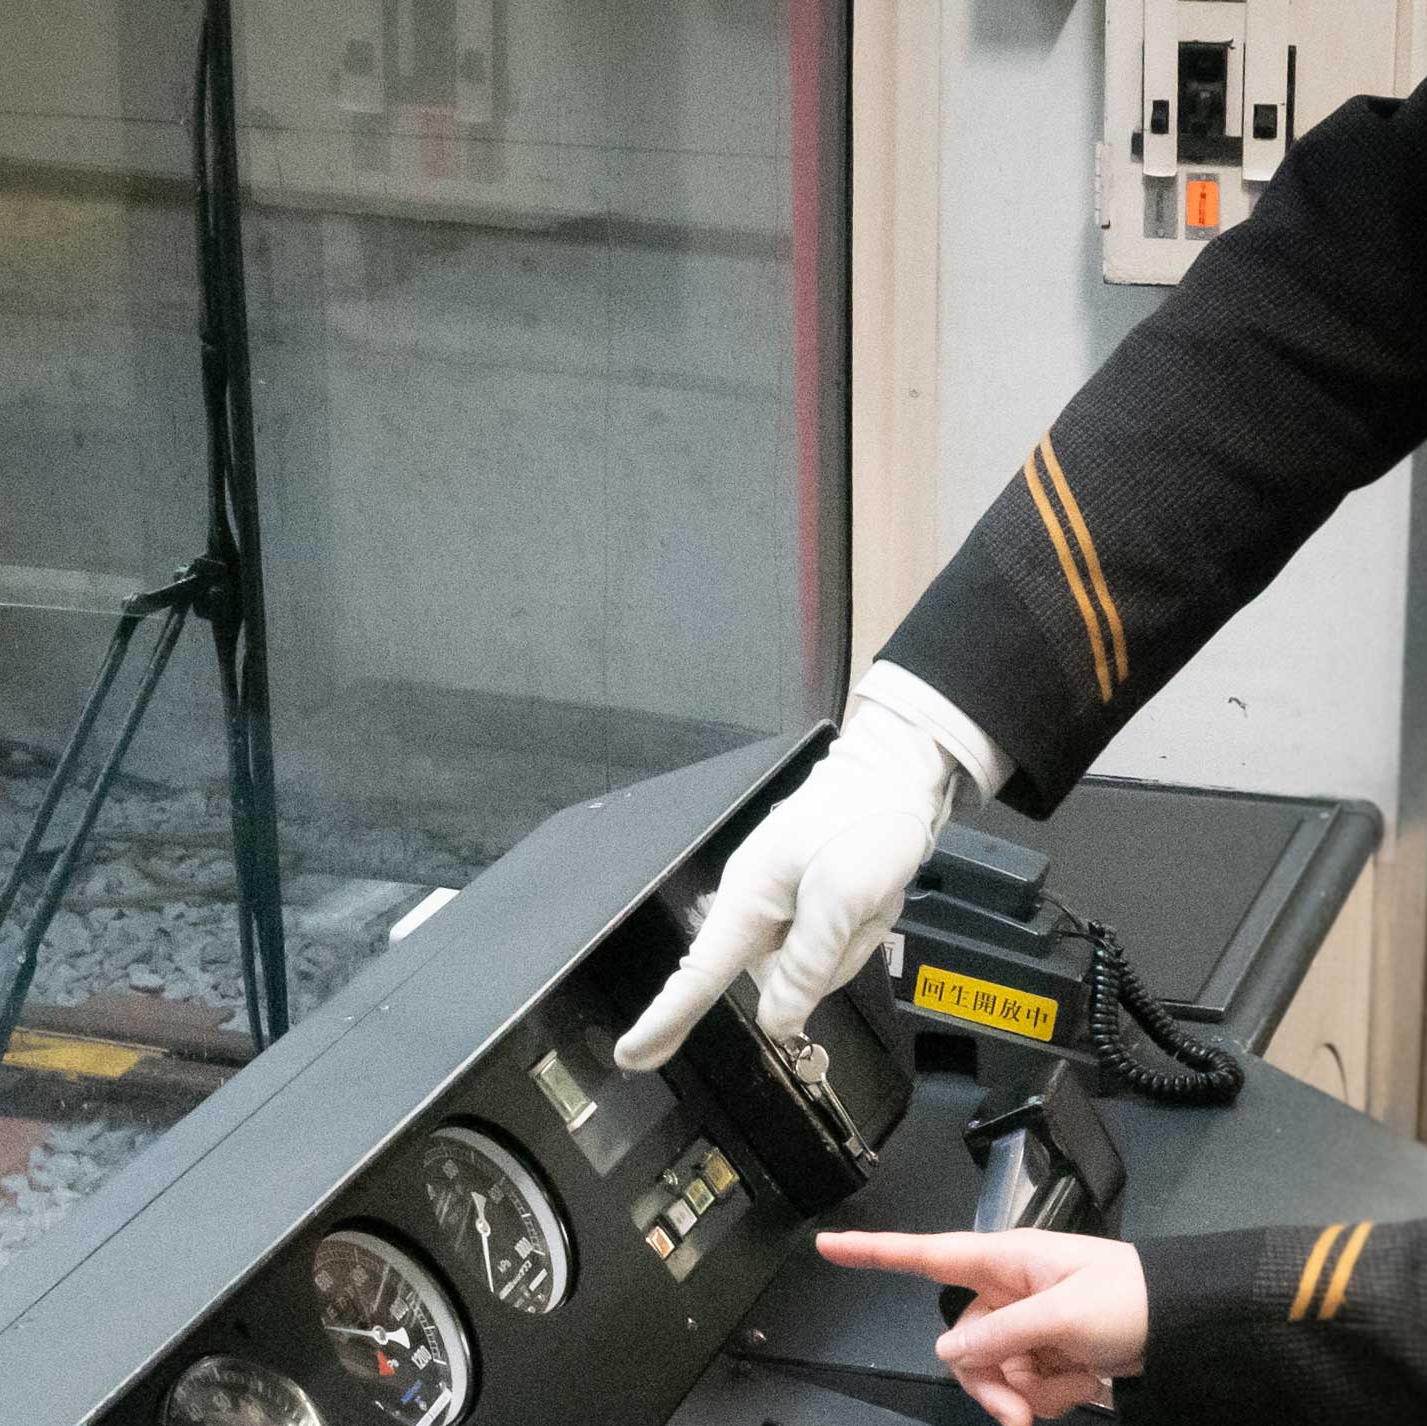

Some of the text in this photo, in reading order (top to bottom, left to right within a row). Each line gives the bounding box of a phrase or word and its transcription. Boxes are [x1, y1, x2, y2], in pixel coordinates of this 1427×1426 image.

[921, 977, 1048, 1029] 回生開放中
[411, 1345, 433, 1370] 1200
